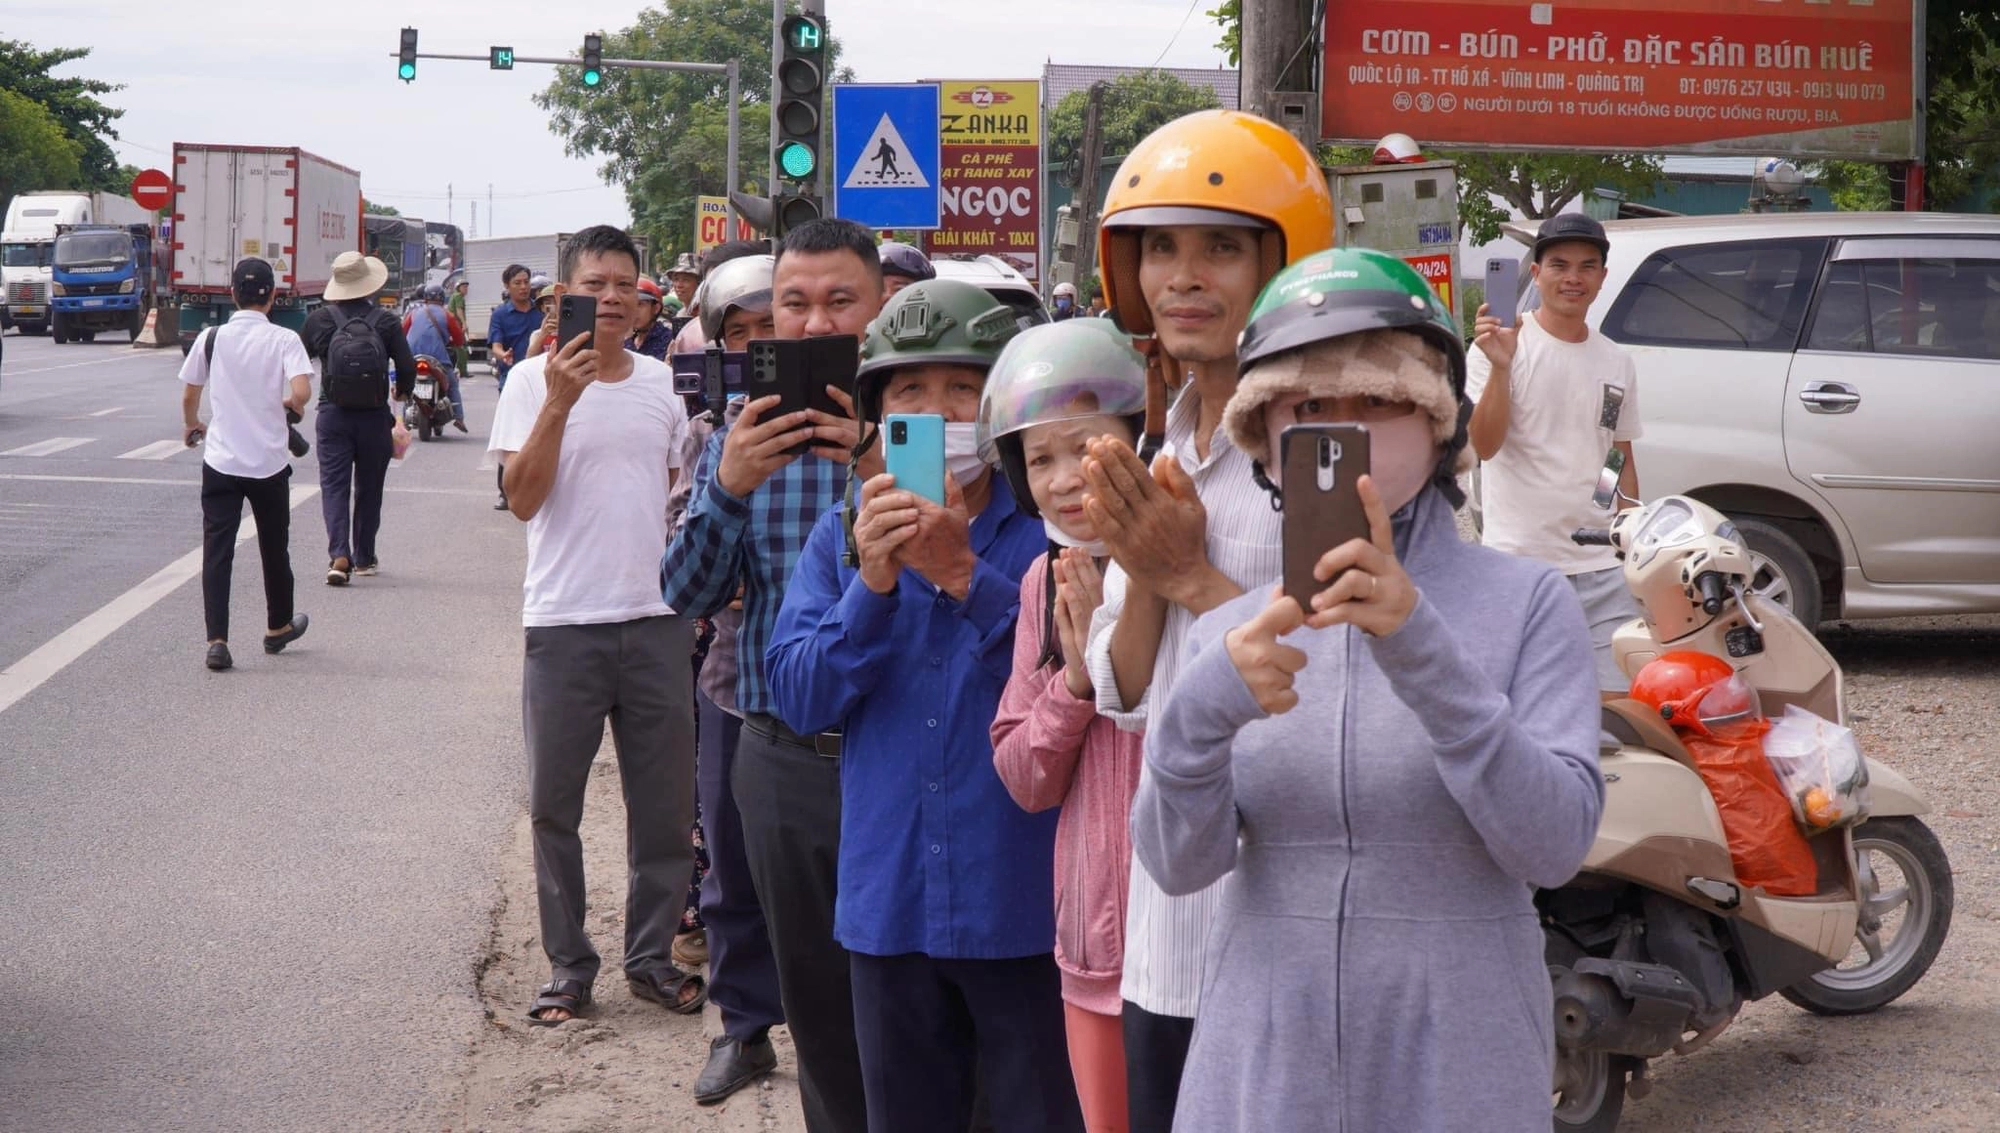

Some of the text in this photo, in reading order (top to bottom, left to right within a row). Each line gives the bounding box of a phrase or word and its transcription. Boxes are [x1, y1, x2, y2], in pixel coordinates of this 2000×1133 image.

[802, 26, 819, 48] 14
[499, 51, 512, 66] 14
[1362, 29, 1430, 55] CƠM
[1460, 29, 1518, 58] BÚN
[1623, 34, 1681, 69] ĐẶC
[1690, 36, 1745, 68] SẢN
[1755, 39, 1811, 70] BÚN
[1386, 63, 1402, 88] LỘ
[1432, 68, 1448, 85] TT
[1501, 68, 1532, 89] VĨNH
[1536, 72, 1565, 90] LINH
[1577, 70, 1620, 94] QUẢNG
[1623, 76, 1644, 96] TRỊ
[1703, 78, 1737, 95] 0976
[1740, 80, 1764, 96] 257
[1766, 80, 1790, 98] 434
[1803, 81, 1832, 99] 0913
[1836, 82, 1857, 99] 410
[1860, 84, 1885, 100] 079
[1558, 101, 1575, 115] 18
[1618, 100, 1670, 117] KHÔNG
[1675, 104, 1716, 121] ĐƯỢC
[941, 114, 1028, 134] ZANKA
[984, 151, 1015, 165] PHÊ
[941, 167, 1034, 181] ẠT RANG XAY
[941, 186, 1031, 225] NGỌC
[963, 228, 996, 246] KHÁT
[1008, 231, 1035, 246] TAXI
